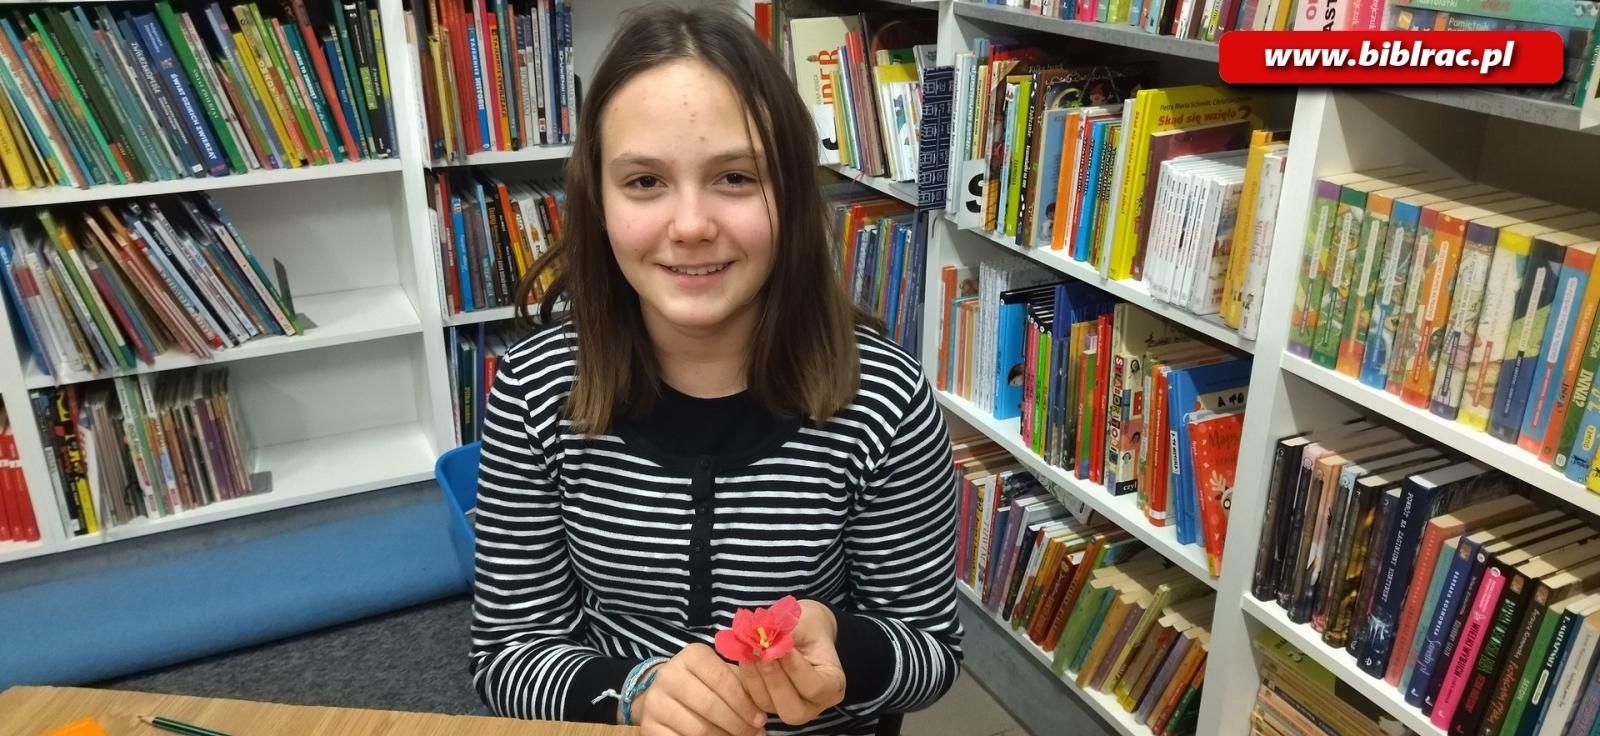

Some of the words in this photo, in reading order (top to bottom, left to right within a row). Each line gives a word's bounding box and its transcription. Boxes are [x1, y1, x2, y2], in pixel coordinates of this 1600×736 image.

[170, 72, 186, 96] ŚWIAT
[181, 96, 199, 125] DZIKICH
[195, 124, 217, 160] ZWIERZĄT
[1157, 115, 1184, 127] Skąd
[1186, 112, 1202, 124] się
[1572, 368, 1595, 408] INNA?
[1400, 518, 1407, 528] NA
[1434, 599, 1449, 636] KOSMOWSKA
[1466, 622, 1481, 648] WIELKI
[1457, 647, 1473, 678] WYBUCH
